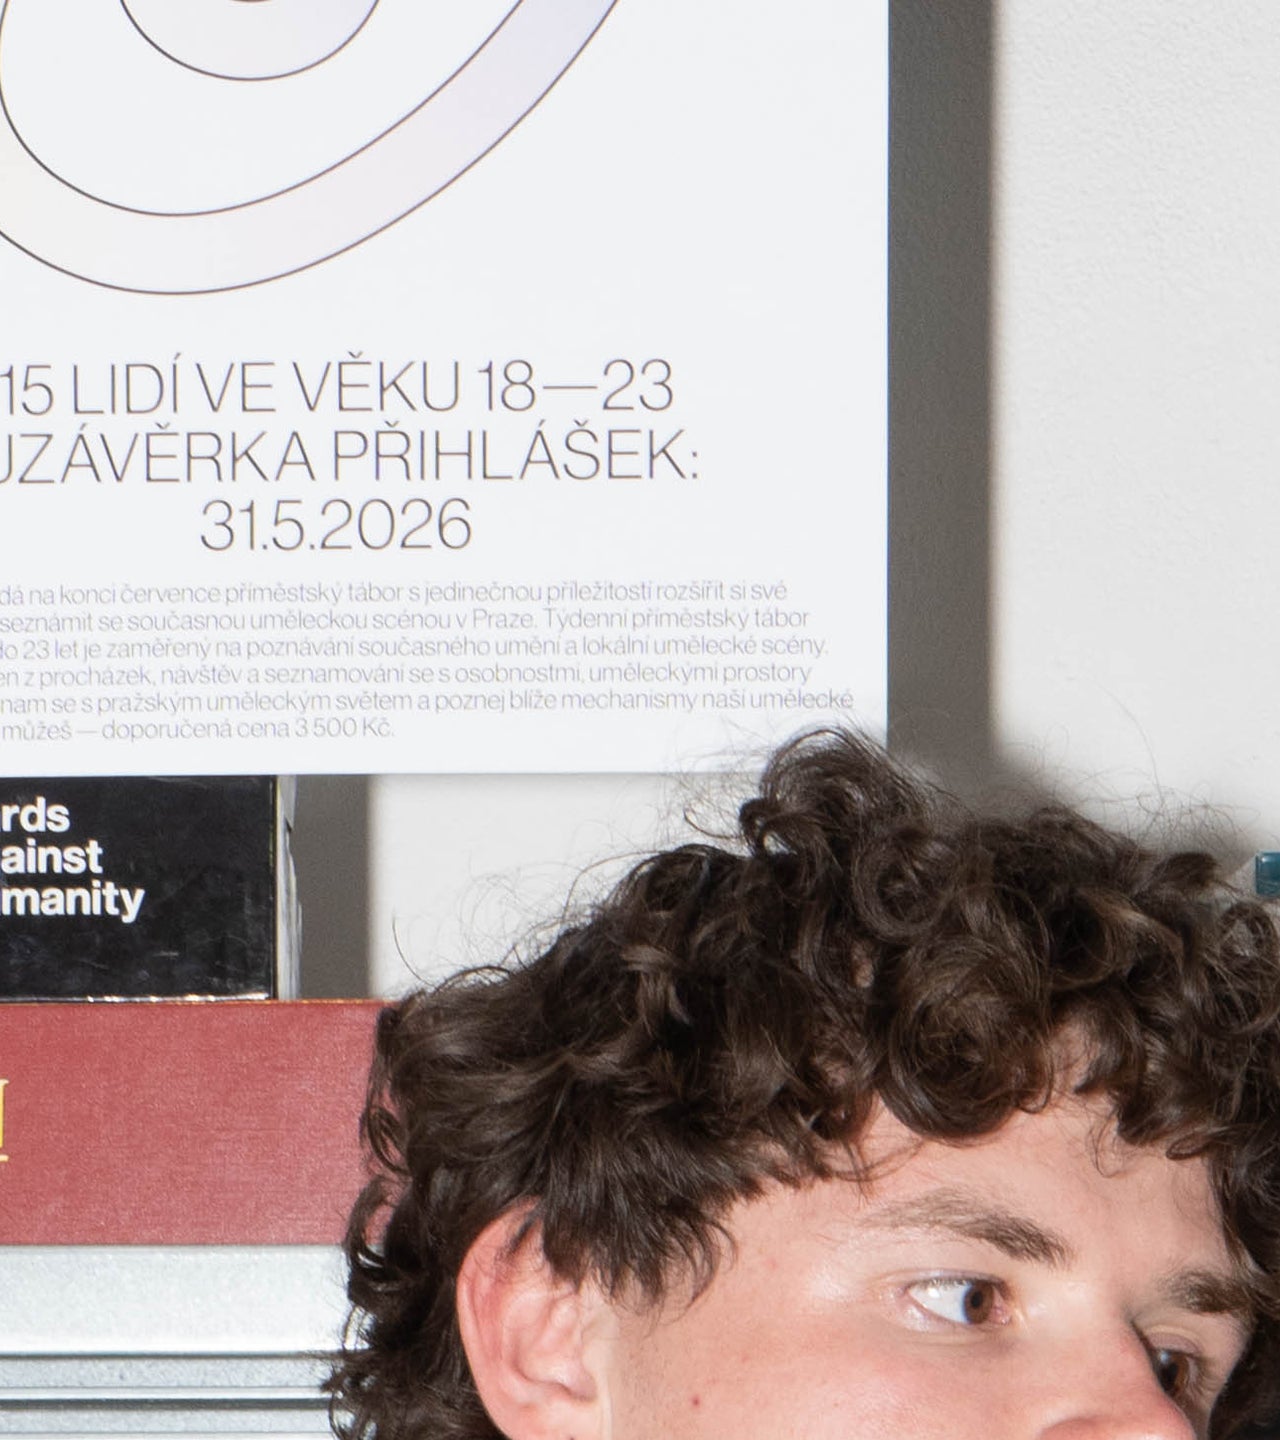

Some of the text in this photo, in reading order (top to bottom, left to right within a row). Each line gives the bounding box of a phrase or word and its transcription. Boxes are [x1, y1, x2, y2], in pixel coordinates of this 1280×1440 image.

[0, 364, 54, 416] 15
[73, 352, 181, 415] LIDÍ
[195, 361, 277, 413] VE
[292, 351, 459, 412] VĚKU
[332, 418, 700, 482] PŘIHLÁŠEK:
[200, 497, 472, 552] 31.5.2026
[28, 589, 56, 605] na
[59, 583, 116, 605] konci
[119, 582, 221, 604] července
[222, 581, 343, 608] příměstský
[346, 581, 404, 602] tábor
[423, 579, 542, 606] jedinečnou
[544, 578, 652, 605] příležitostí
[656, 578, 725, 599] rozšířit
[729, 578, 746, 599] si
[750, 577, 787, 598] své
